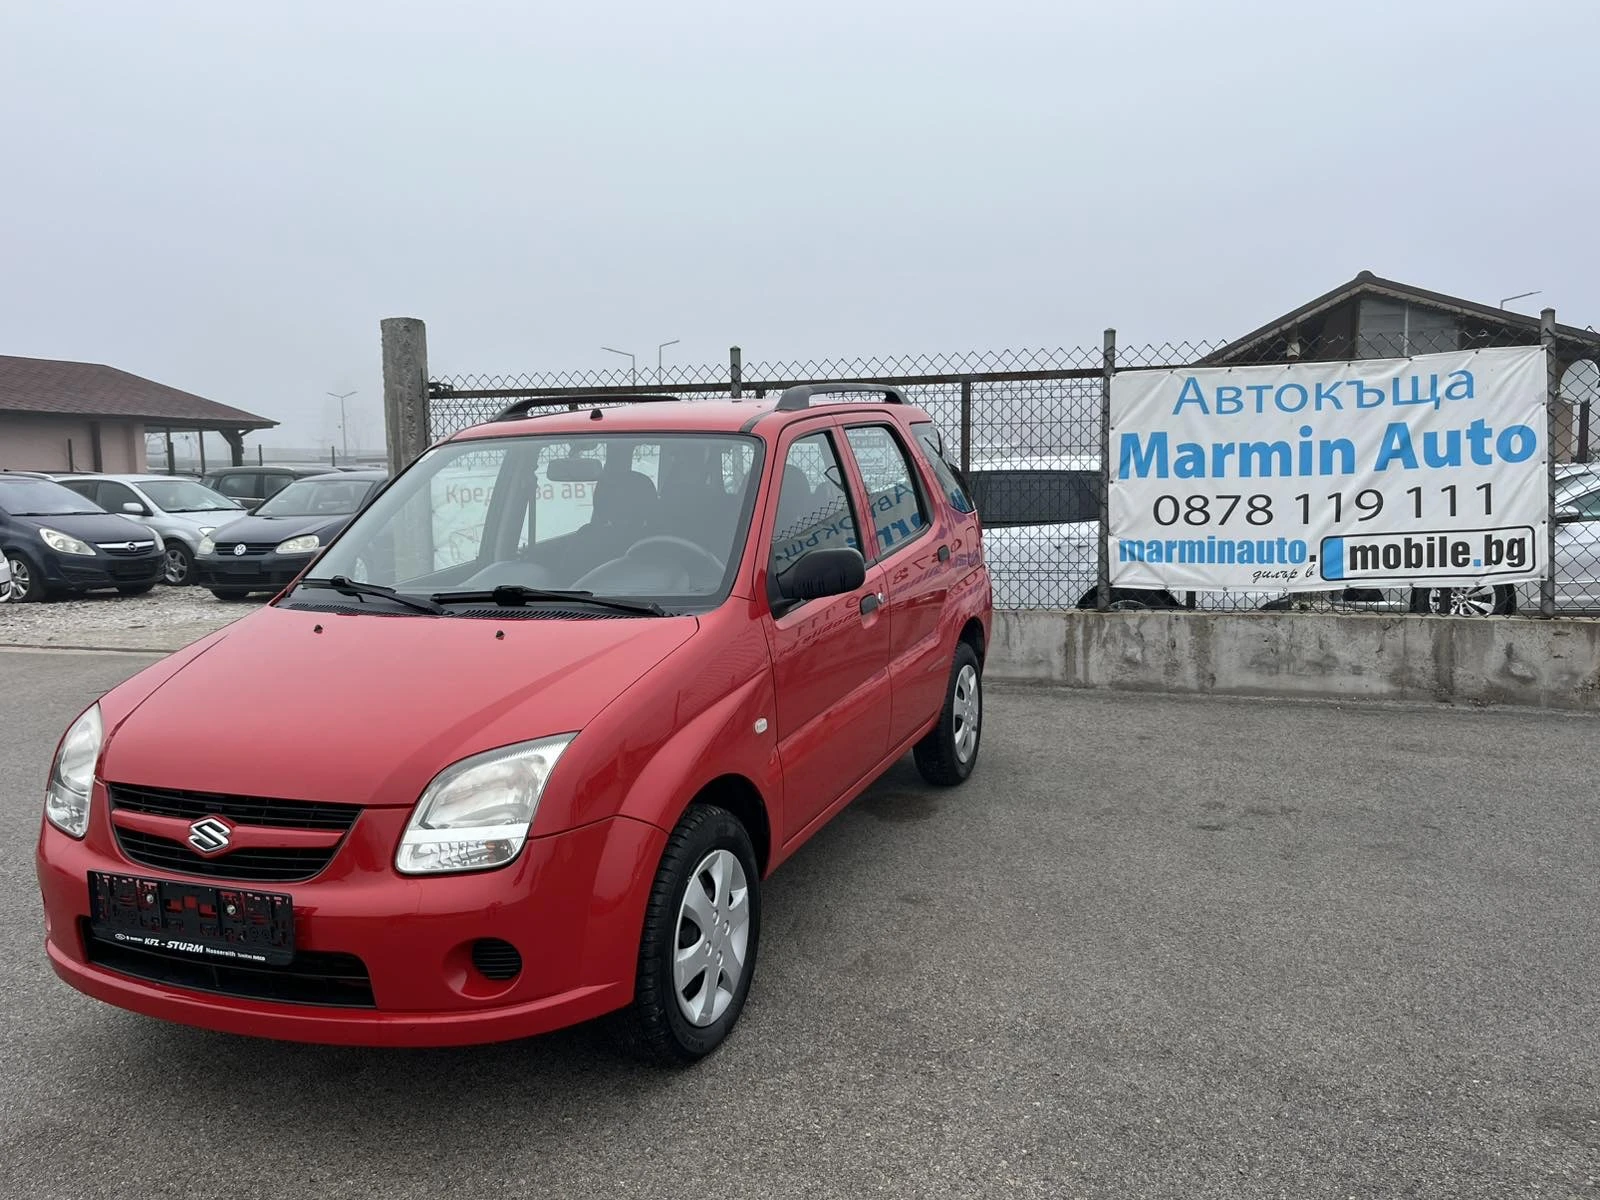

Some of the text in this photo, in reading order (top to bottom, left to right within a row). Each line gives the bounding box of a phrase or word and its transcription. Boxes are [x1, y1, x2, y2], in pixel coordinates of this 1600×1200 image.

[1172, 369, 1475, 416] Автокъща
[1118, 418, 1538, 480] Marmin Auto
[1153, 482, 1493, 526] 0878 119 111
[1348, 533, 1528, 571] mobile.bg
[1252, 568, 1298, 584] дилър
[144, 937, 160, 947] KFZ
[166, 940, 204, 954] STURM
